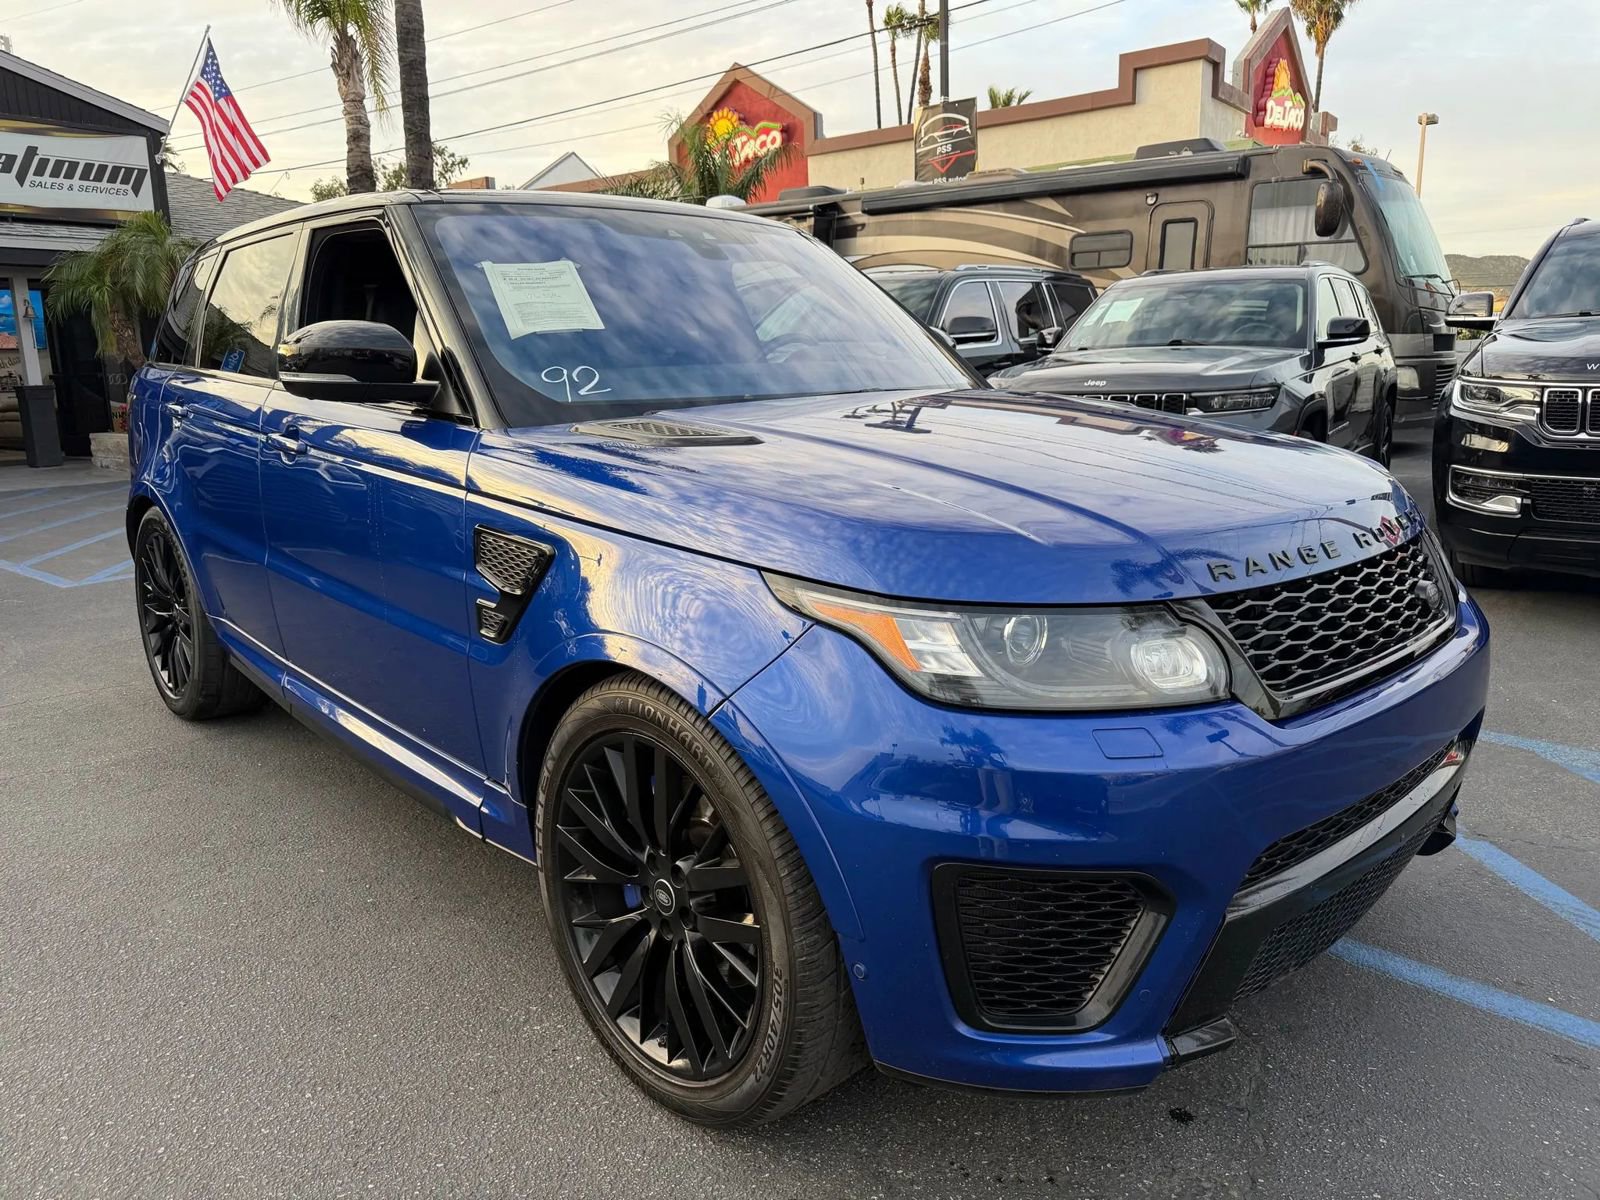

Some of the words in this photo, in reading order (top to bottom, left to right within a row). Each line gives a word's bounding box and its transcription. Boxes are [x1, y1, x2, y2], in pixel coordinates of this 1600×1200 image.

[936, 144, 952, 155] PSS
[29, 180, 64, 191] SALES
[66, 183, 74, 191] &
[78, 184, 129, 196] SERVICES
[541, 365, 612, 403] 92
[1083, 379, 1107, 388] Jeep
[1206, 540, 1342, 583] RANGE
[1352, 508, 1417, 549] ROVER
[626, 697, 716, 771] LIONHART
[753, 962, 783, 1083] 305/40R22
